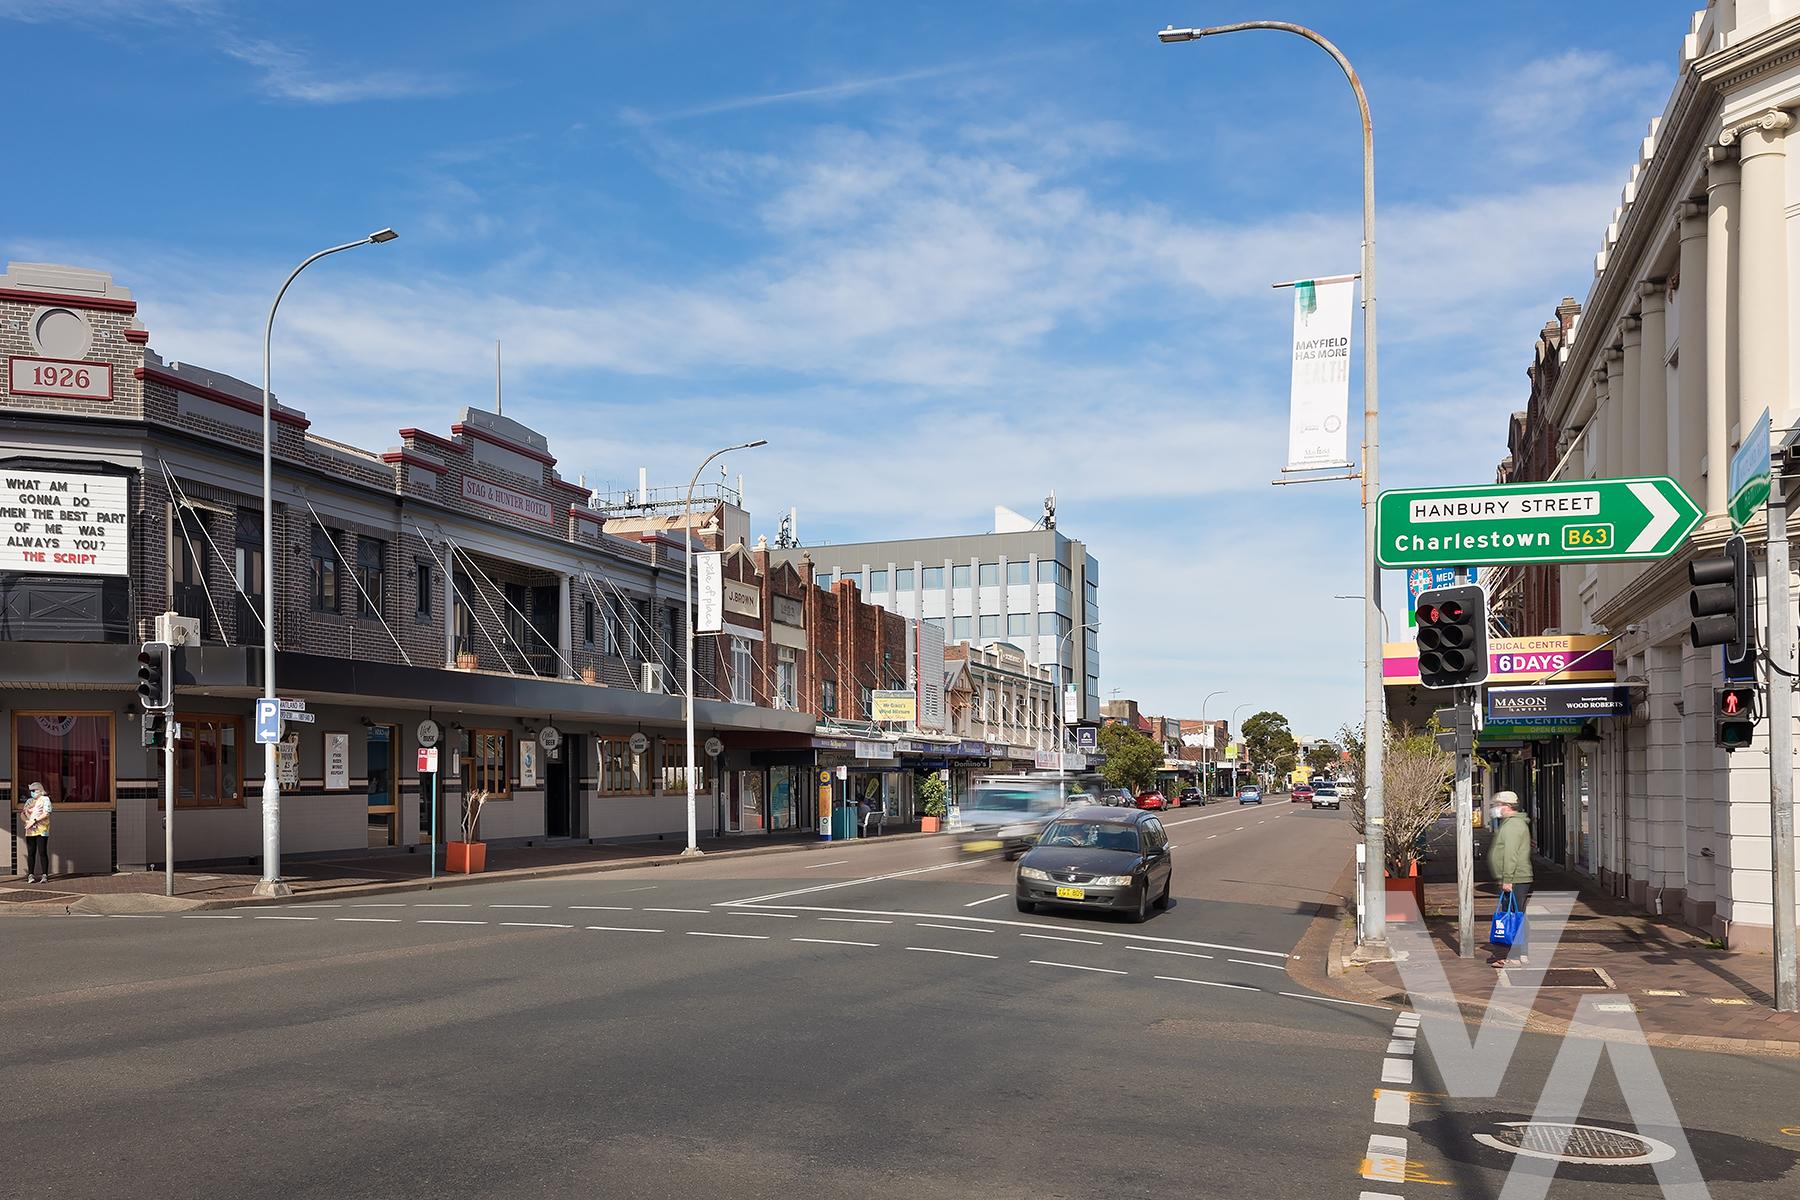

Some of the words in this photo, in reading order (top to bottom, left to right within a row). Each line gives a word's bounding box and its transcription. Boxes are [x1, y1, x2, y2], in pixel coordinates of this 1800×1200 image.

[1296, 337, 1348, 350] MAYFIELD
[1295, 350, 1316, 360] HAS
[1318, 348, 1347, 359] MORE
[33, 366, 90, 389] 1926
[6, 478, 41, 490] WHAT
[49, 481, 68, 492] AM
[83, 483, 88, 493] I
[19, 494, 61, 506] GONNA
[73, 497, 90, 507] DO
[467, 480, 486, 498] STAG
[487, 488, 494, 500] &
[495, 490, 524, 511] HUNTER
[525, 500, 548, 518] HOTEL
[1415, 501, 1509, 517] HANBURY
[1521, 497, 1594, 513] STREET
[32, 509, 54, 520] THE
[60, 510, 88, 521] BEST
[97, 512, 126, 524] PART
[14, 522, 31, 533] OF
[45, 524, 63, 534] ME
[78, 525, 105, 537] WAS
[7, 536, 60, 548] ALWAYS
[73, 539, 106, 551] YOU?
[1394, 531, 1550, 552] Charlestown
[1568, 529, 1607, 545] B63
[22, 551, 46, 563] THE
[53, 553, 97, 564] SCRIPT
[1489, 641, 1525, 651] EDICAL
[1528, 640, 1569, 650] CENTRE
[1495, 697, 1547, 707] MASON
[261, 703, 277, 724] P
